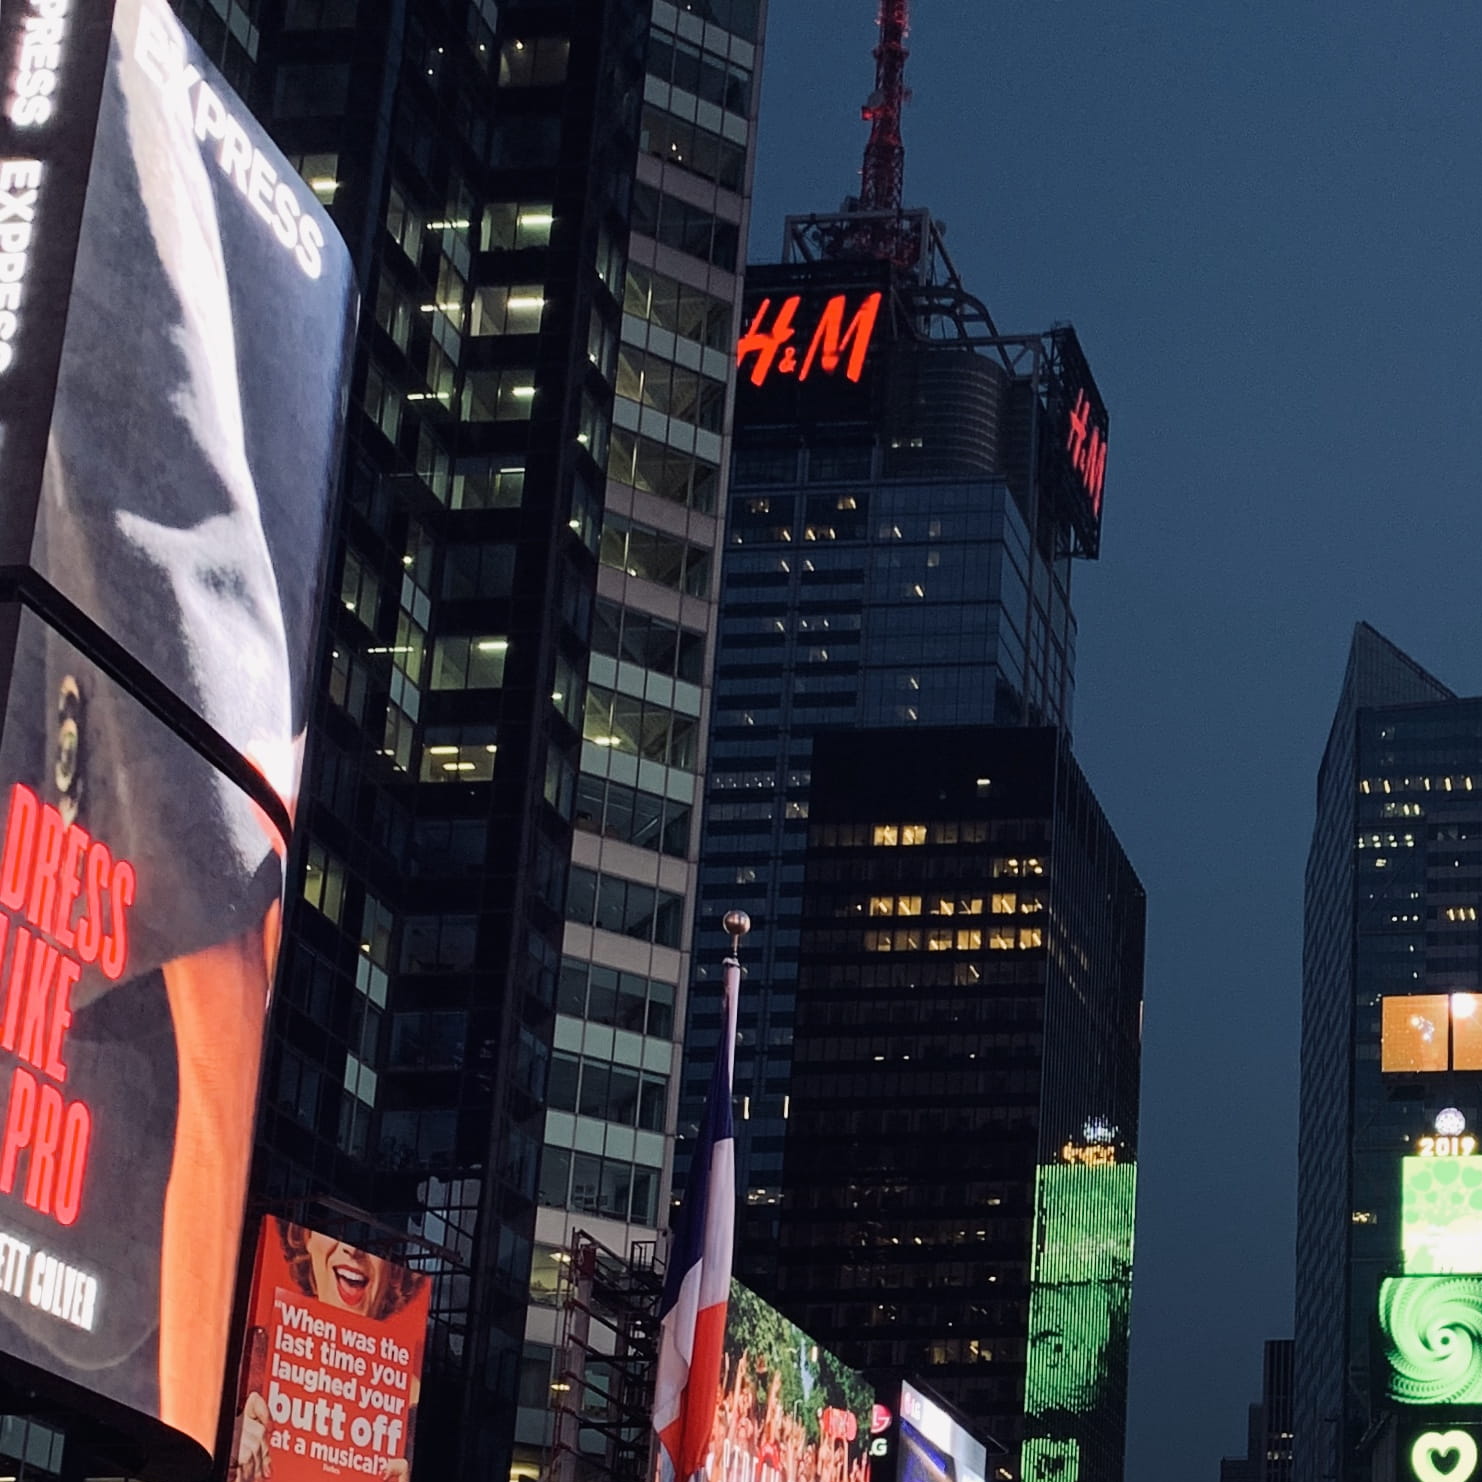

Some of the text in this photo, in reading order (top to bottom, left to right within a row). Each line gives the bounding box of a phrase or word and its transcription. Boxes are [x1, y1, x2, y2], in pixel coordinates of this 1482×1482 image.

[134, 0, 325, 280] EXPRESS
[738, 292, 881, 386] H&M
[1067, 388, 1107, 518] H&M
[1, 782, 136, 979] DRESS
[0, 1069, 91, 1226] PRO
[1418, 1135, 1477, 1157] 2019
[29, 1251, 98, 1333] CULVER
[272, 1354, 405, 1415] laughed your
[275, 1325, 408, 1390] last time you
[341, 1328, 376, 1354] was
[380, 1337, 409, 1365] the
[268, 1381, 403, 1457] butt off
[270, 1430, 291, 1451] at
[294, 1438, 306, 1456] a
